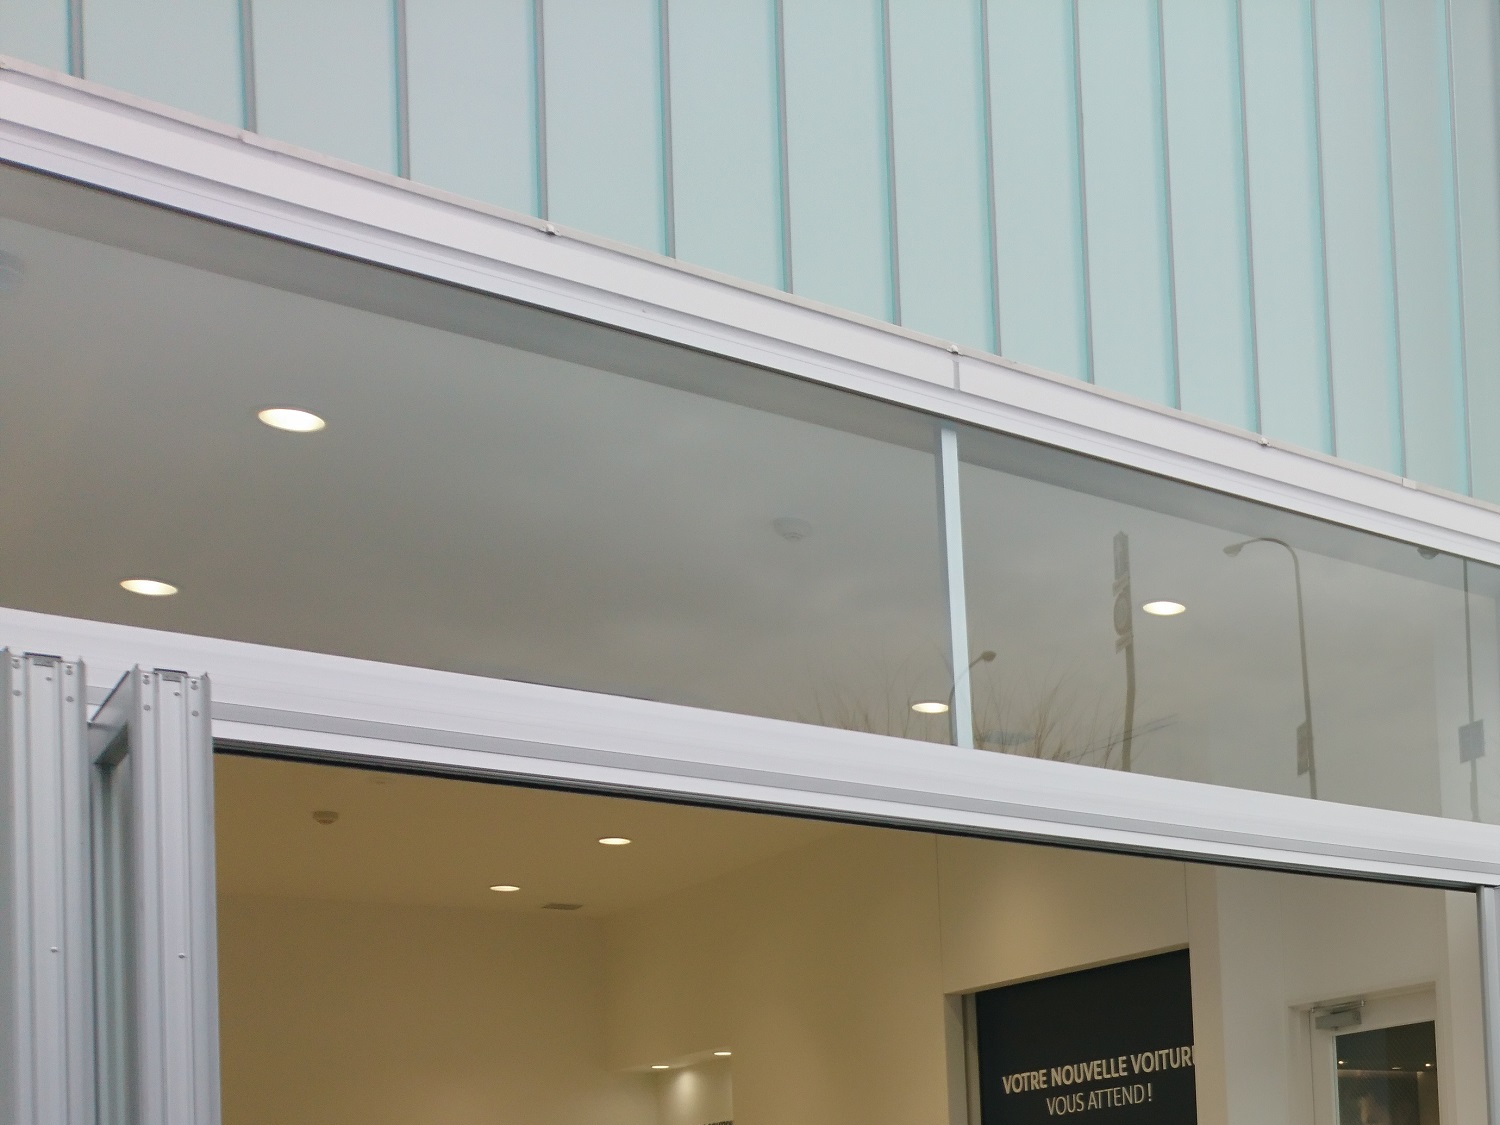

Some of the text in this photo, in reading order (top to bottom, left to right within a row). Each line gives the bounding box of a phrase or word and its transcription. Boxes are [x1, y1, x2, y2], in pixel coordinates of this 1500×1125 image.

[1002, 1046, 1194, 1094] VOTRE NOUVELLE VOITUR
[1046, 1092, 1084, 1116] VOUS
